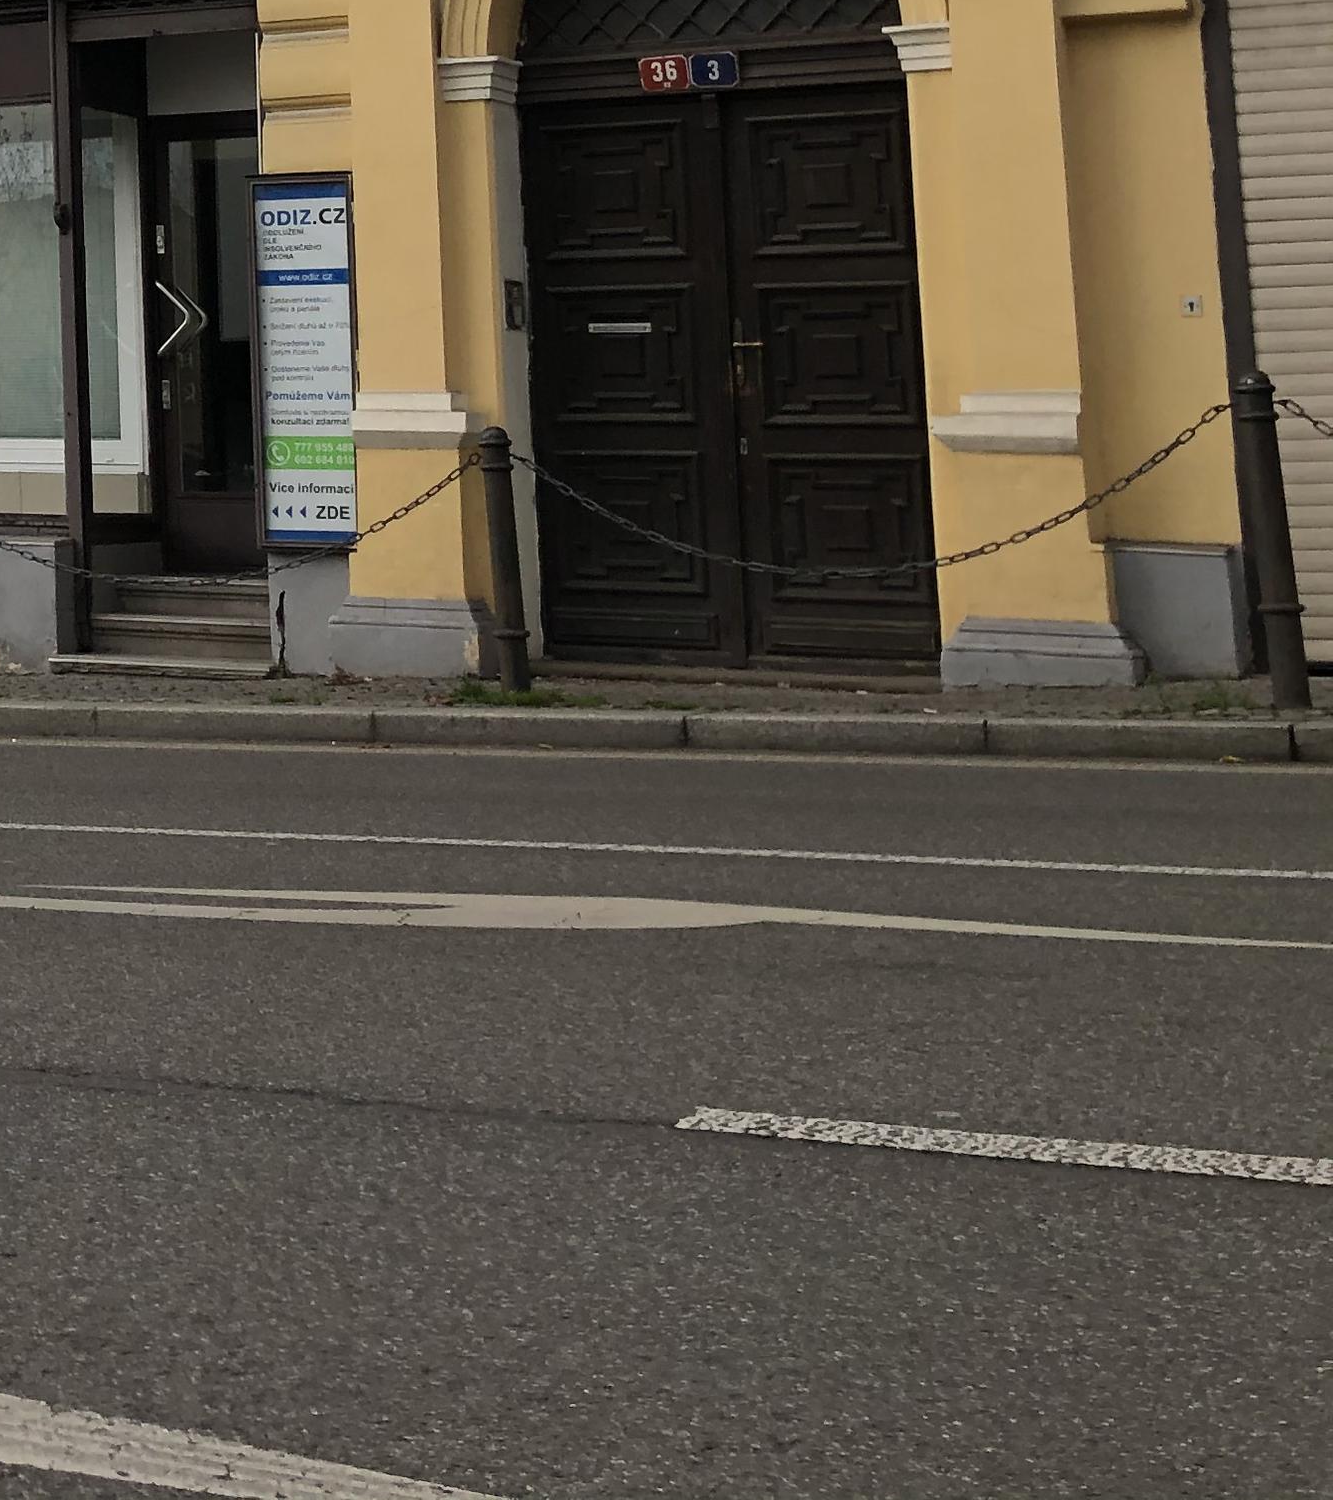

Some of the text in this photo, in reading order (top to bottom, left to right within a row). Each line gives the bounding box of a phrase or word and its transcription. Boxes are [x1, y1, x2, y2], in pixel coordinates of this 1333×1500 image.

[651, 60, 677, 82] 36
[707, 60, 719, 80] 3
[260, 207, 346, 227] ODIZ.CZ
[327, 391, 350, 400] Vám
[271, 417, 313, 425] konzultaci
[316, 506, 351, 520] ZDE
